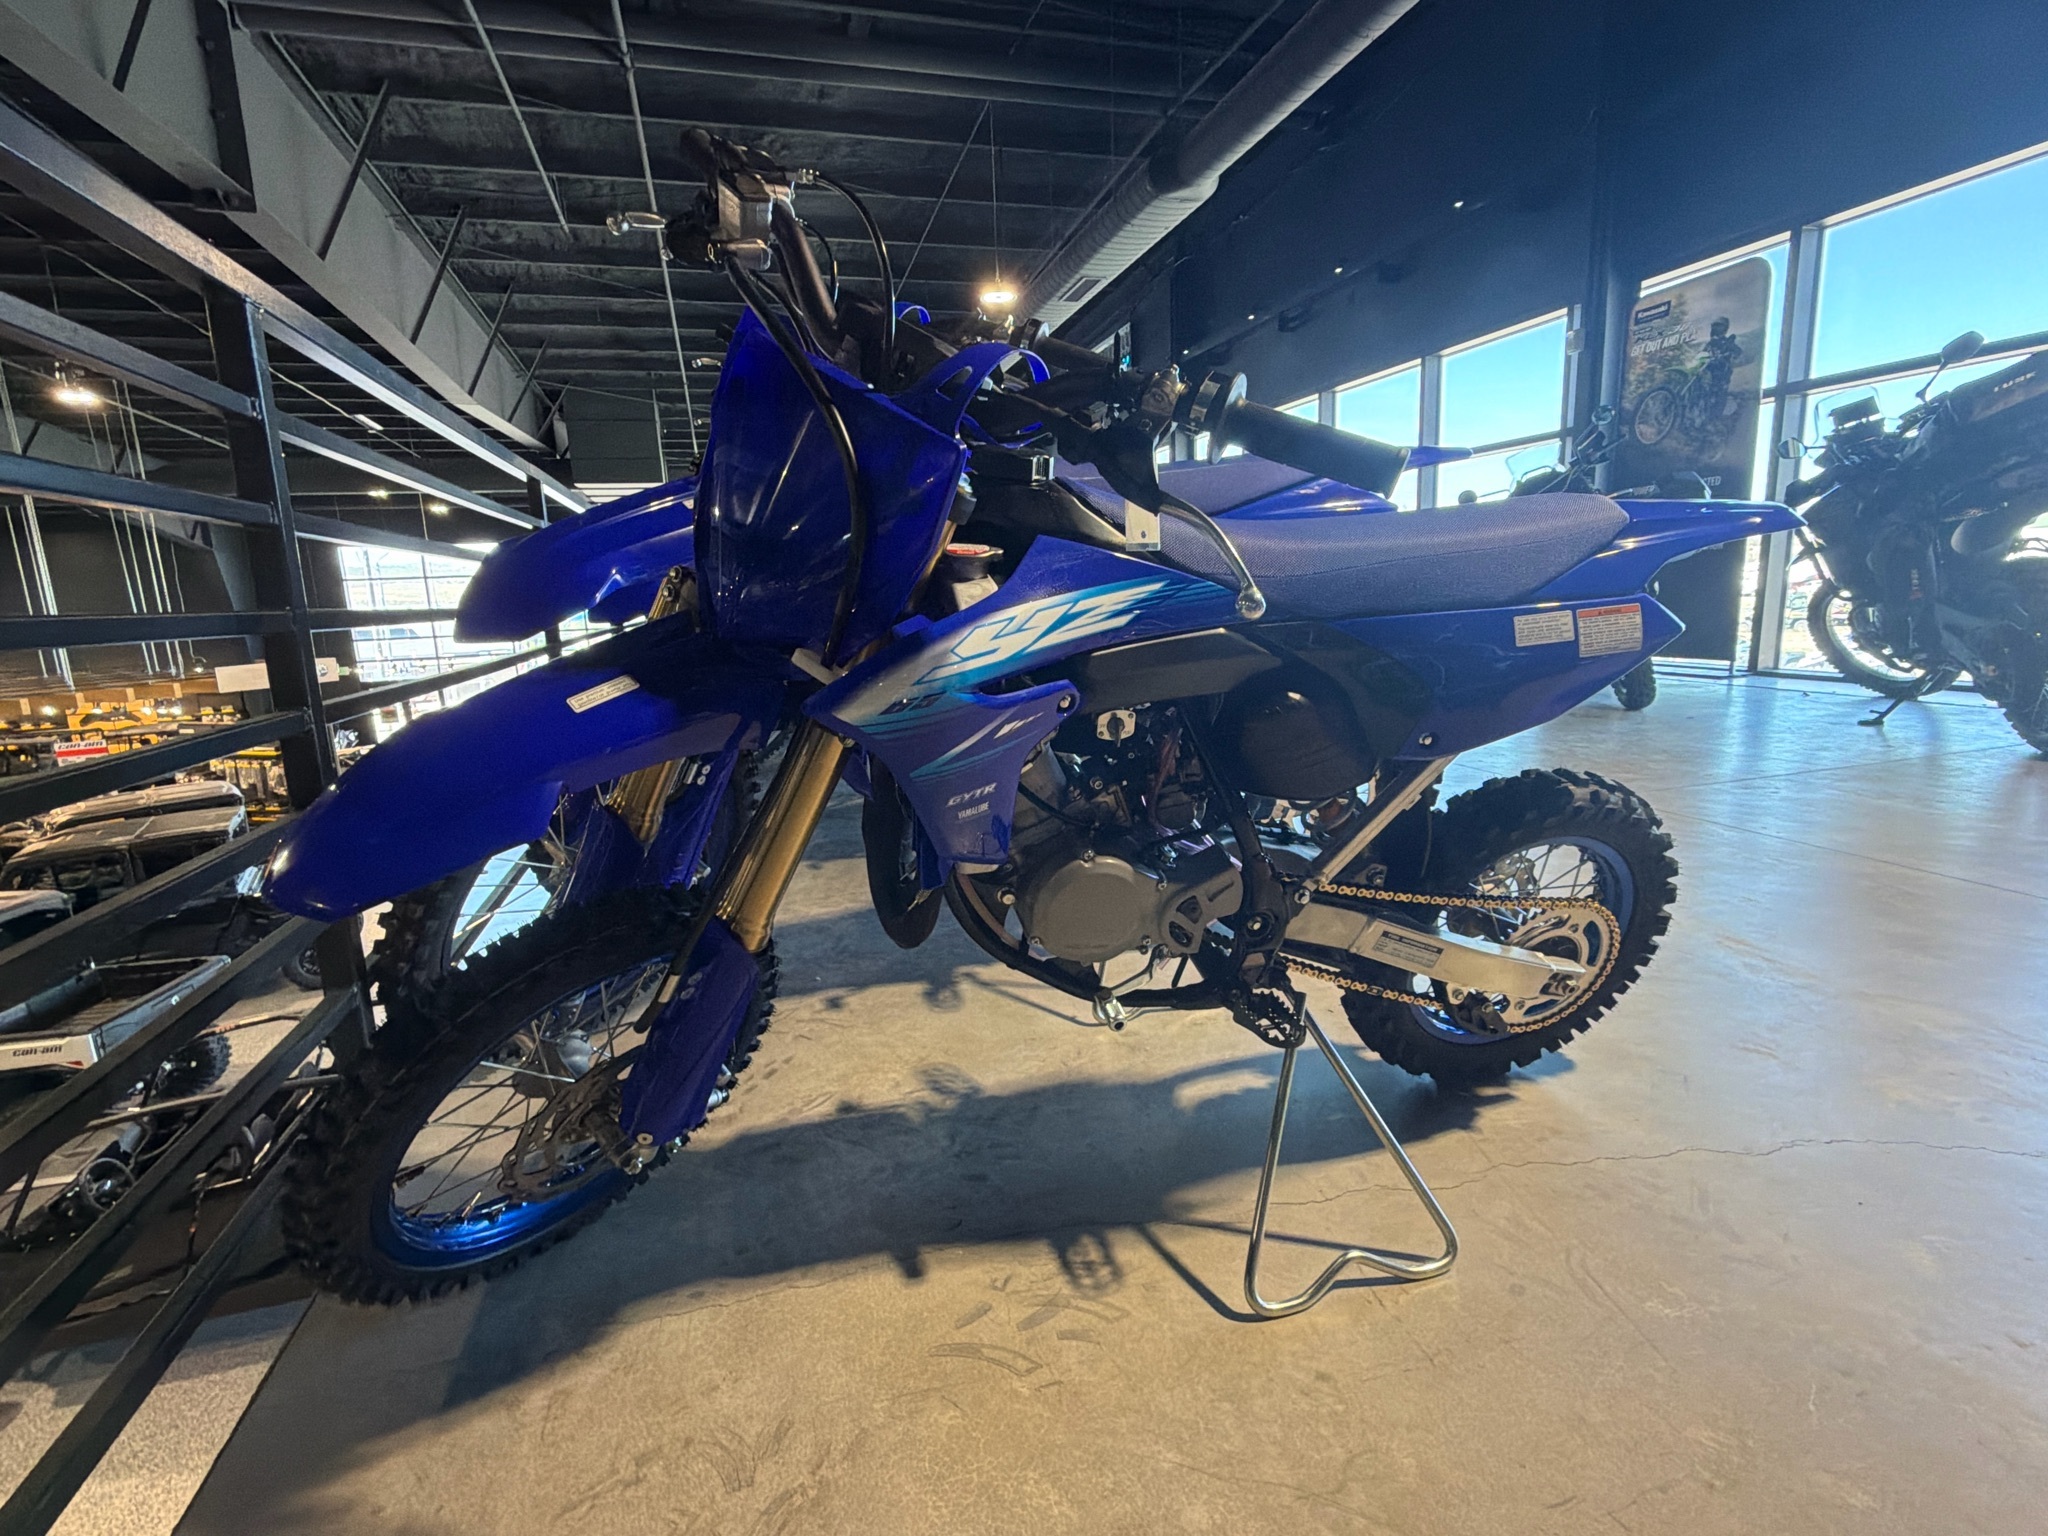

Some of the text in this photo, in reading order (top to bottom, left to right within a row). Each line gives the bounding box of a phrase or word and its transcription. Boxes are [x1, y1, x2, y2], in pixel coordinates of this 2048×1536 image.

[1645, 338, 1662, 353] OUT
[1661, 334, 1680, 349] AND
[945, 782, 998, 808] GYTR
[957, 801, 990, 819] YAMALUBE
